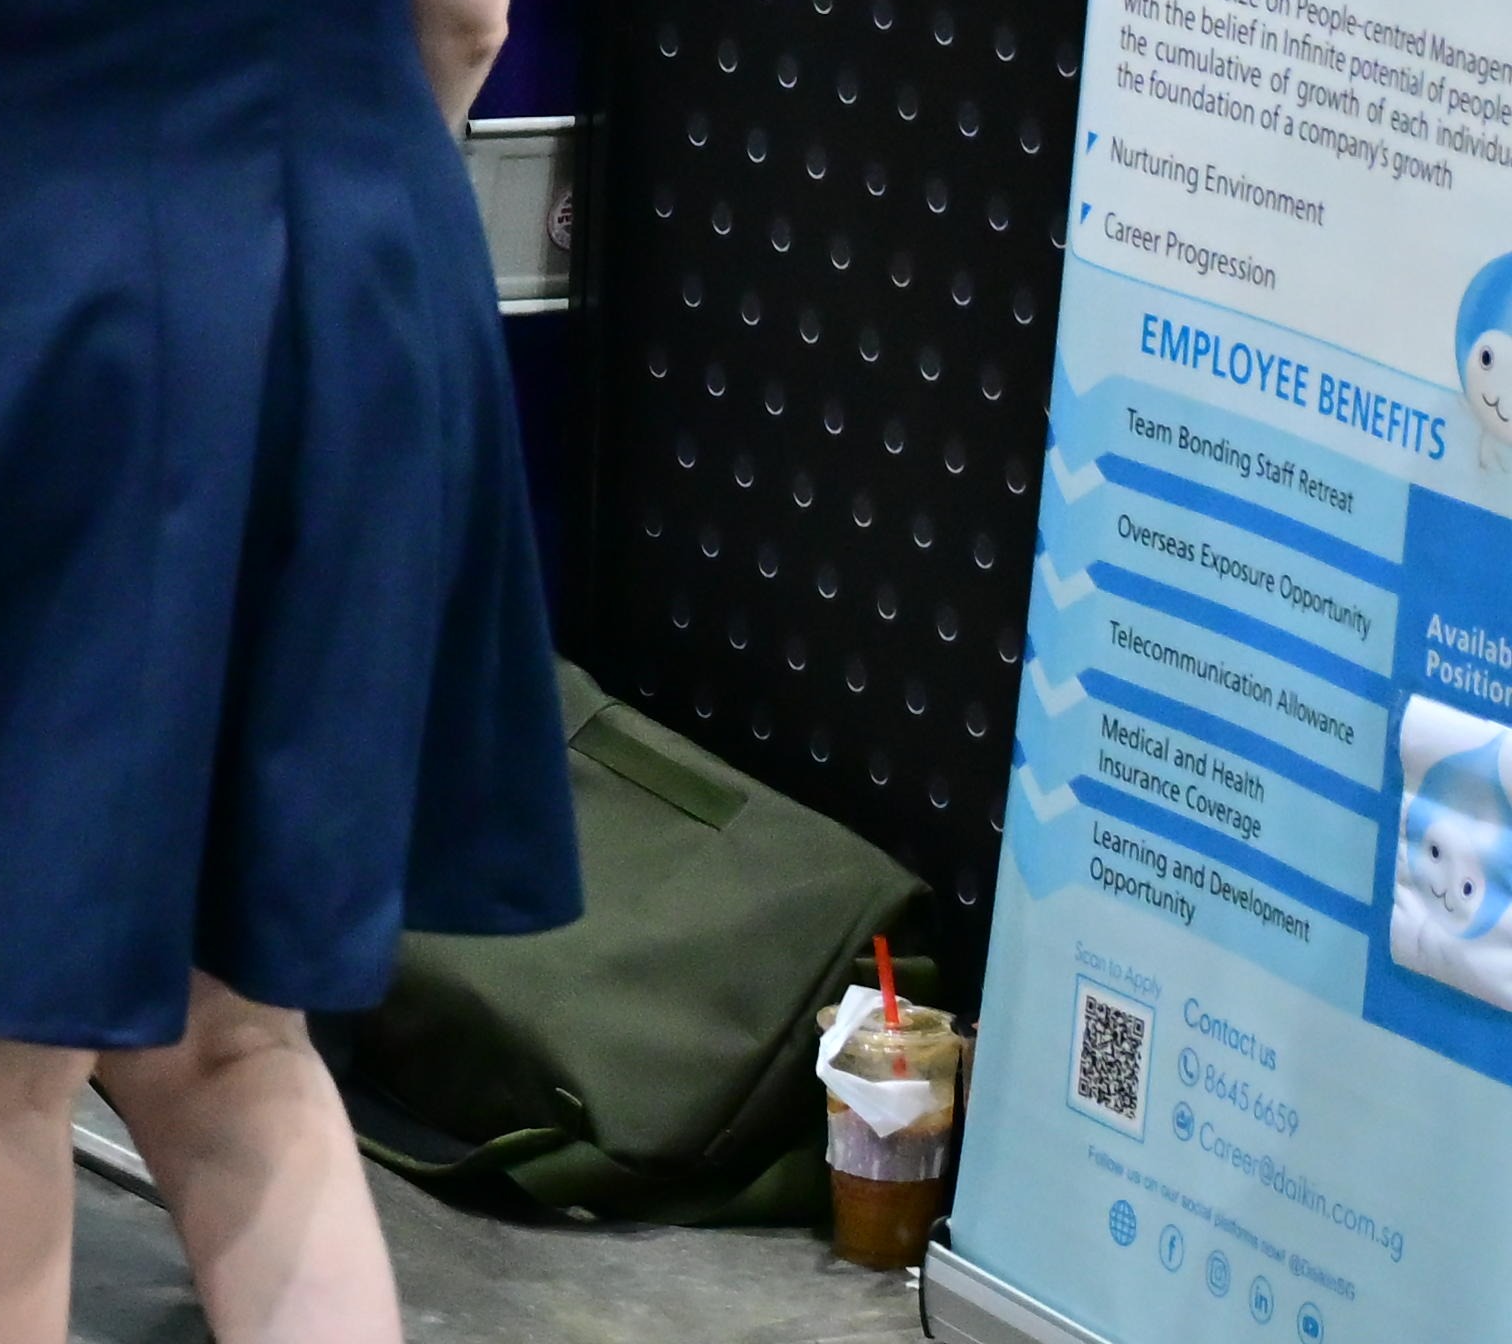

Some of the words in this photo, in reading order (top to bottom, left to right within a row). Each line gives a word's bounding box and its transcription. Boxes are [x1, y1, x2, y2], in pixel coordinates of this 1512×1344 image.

[1110, 135, 1199, 193] Nurturing
[1204, 163, 1324, 226] Environment
[1104, 212, 1161, 252] Career
[1165, 230, 1275, 289] Progression
[1141, 313, 1308, 406] EMPLOYEE
[1318, 372, 1445, 460] BENEFITS
[1127, 407, 1172, 444] Team
[1178, 426, 1251, 478] Bonding
[1255, 453, 1295, 487] Staff
[1299, 468, 1353, 513] Retreat
[1117, 513, 1194, 561] Overseas
[1200, 543, 1274, 592] Exposure
[1279, 574, 1370, 640] Opportunity
[1109, 619, 1272, 706] Telecommunication
[1276, 689, 1354, 745] Allowance
[1426, 613, 1512, 669] Availab
[1099, 749, 1180, 802] Insurance
[1185, 784, 1261, 839] Coverage
[1101, 713, 1169, 761] Medical
[1173, 748, 1207, 776] and
[1212, 758, 1264, 802] Health
[1089, 856, 1195, 926] Opportunity
[1093, 821, 1167, 878] Learning
[1172, 860, 1205, 888] and
[1209, 870, 1309, 942] Development
[1183, 998, 1256, 1059] Contact
[1259, 1044, 1276, 1071] us
[1204, 1064, 1249, 1111] 8645
[1253, 1093, 1299, 1135] 6659
[1199, 1122, 1403, 1261] Career@daikin.com.sg
